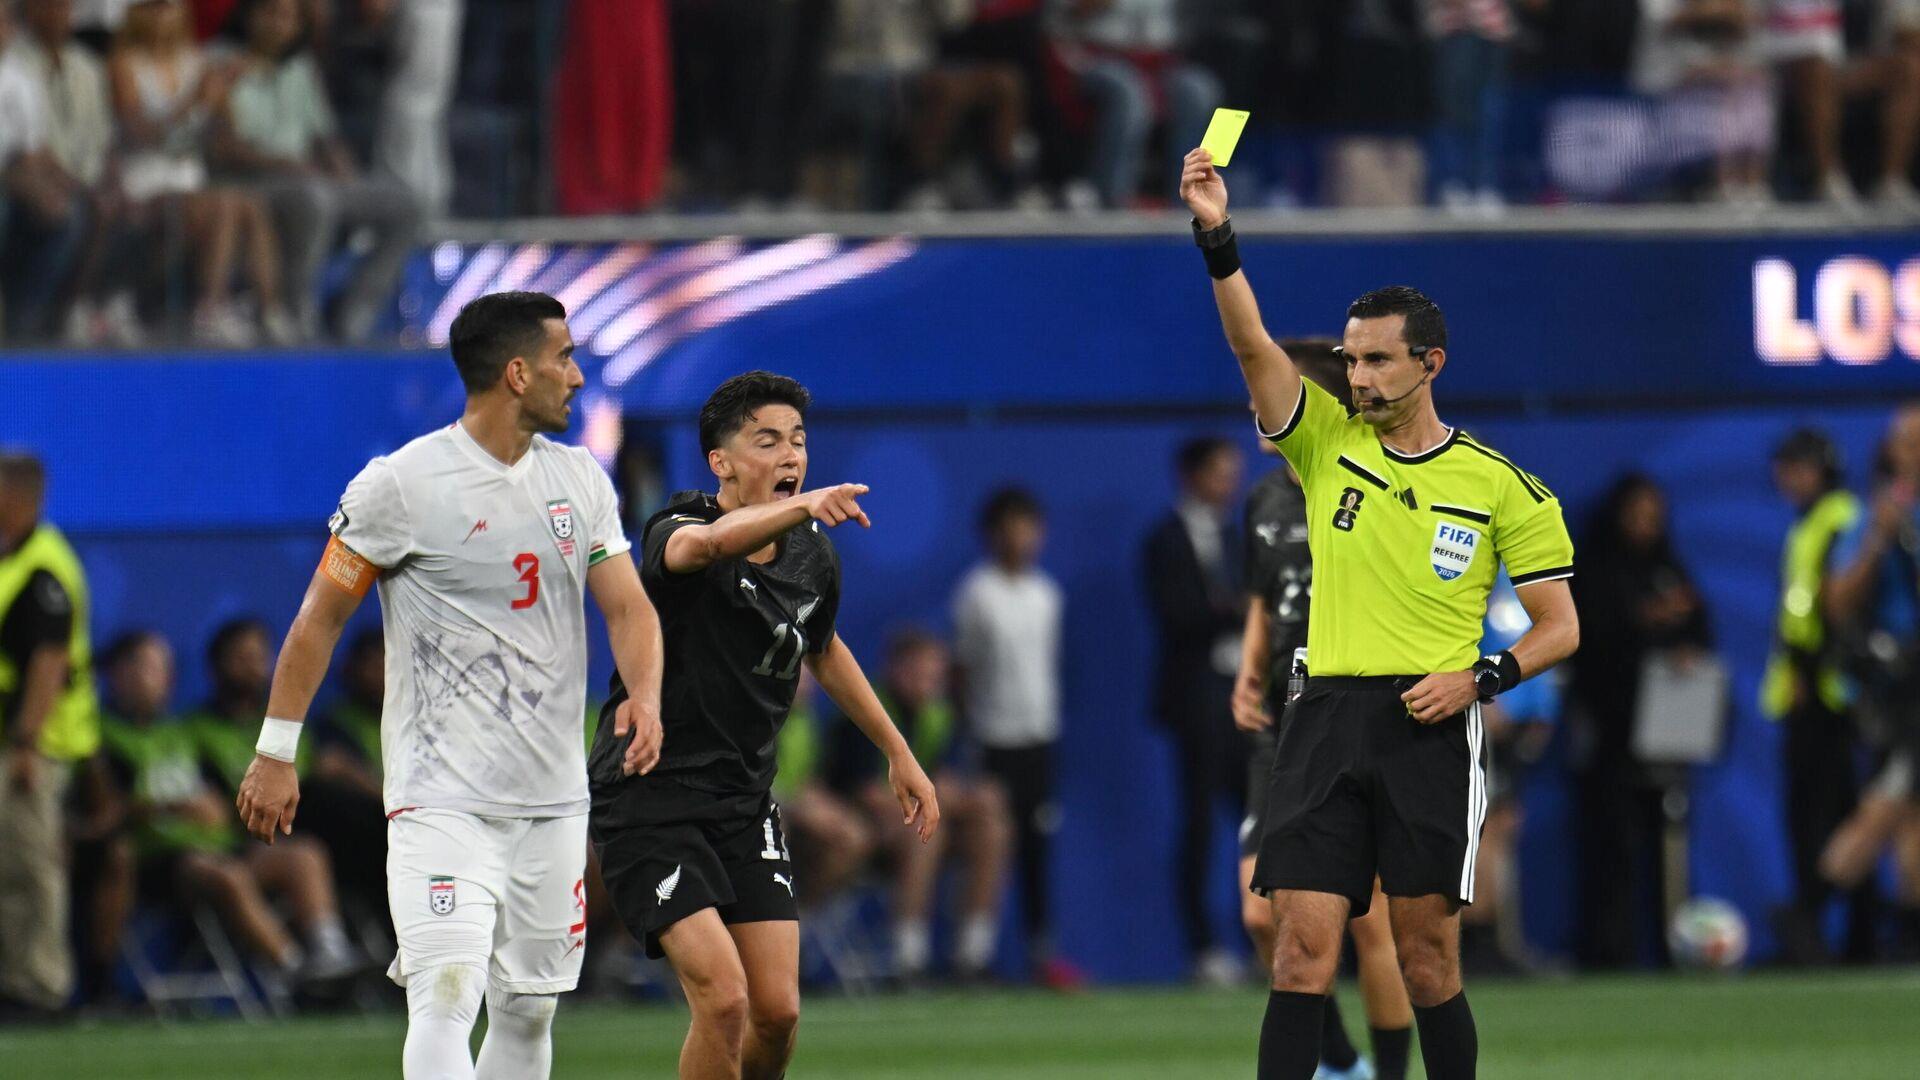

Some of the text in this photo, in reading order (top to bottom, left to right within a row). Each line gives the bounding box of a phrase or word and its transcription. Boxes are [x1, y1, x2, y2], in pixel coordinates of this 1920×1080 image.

[1439, 525, 1474, 547] FIFA
[1433, 547, 1470, 563] REFEREE
[328, 553, 359, 587] UNITES
[511, 553, 539, 610] 3
[1438, 568, 1456, 578] 2026
[751, 622, 803, 681] 11
